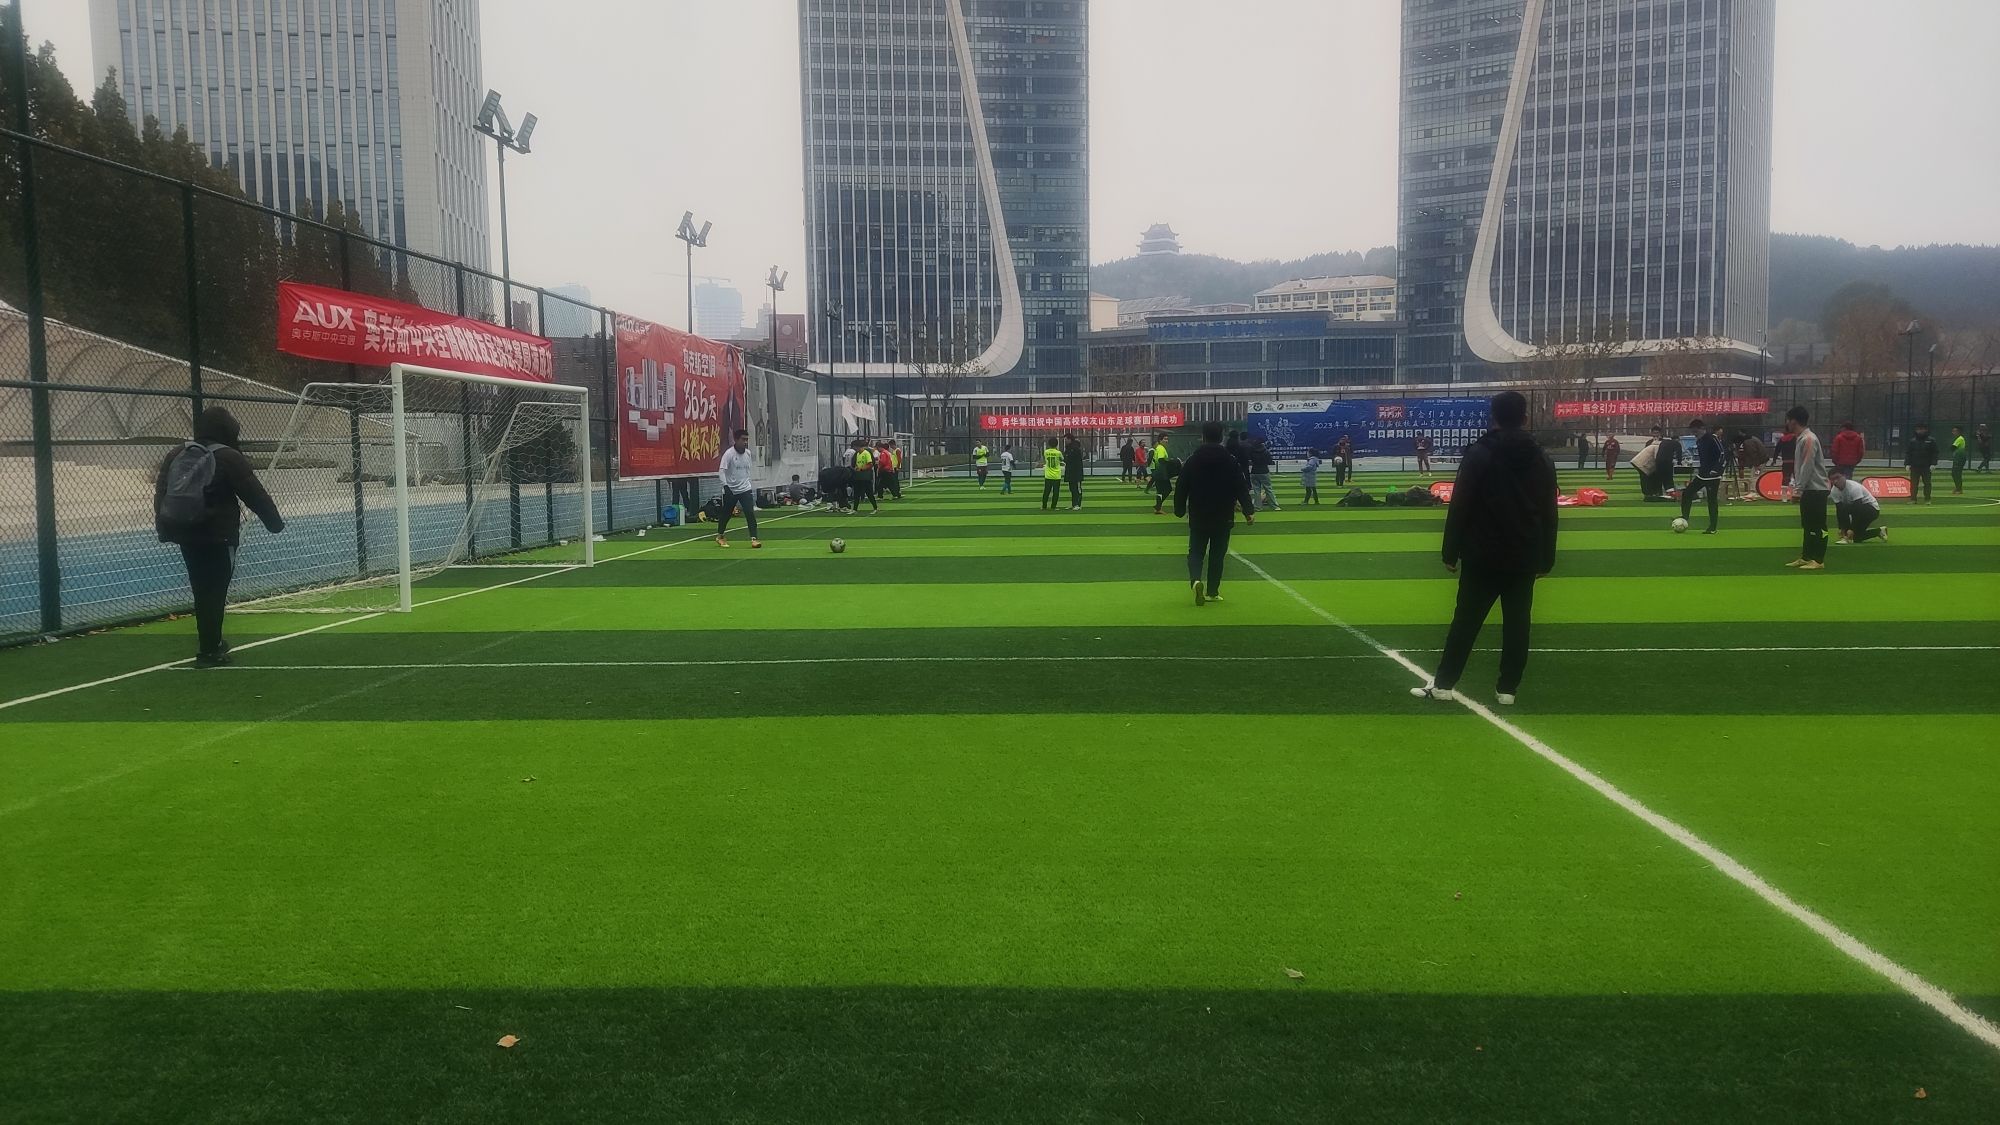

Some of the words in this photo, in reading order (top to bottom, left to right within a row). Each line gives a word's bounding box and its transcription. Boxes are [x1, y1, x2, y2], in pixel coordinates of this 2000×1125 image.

[292, 300, 357, 331] AUX
[291, 328, 356, 345] 奥克斯中央空调
[682, 348, 716, 378] 奥克斯空调
[1002, 414, 1178, 427] 舜华集团祝中国高校校友山东足球赛圆满成功
[679, 423, 721, 462] 只换不修
